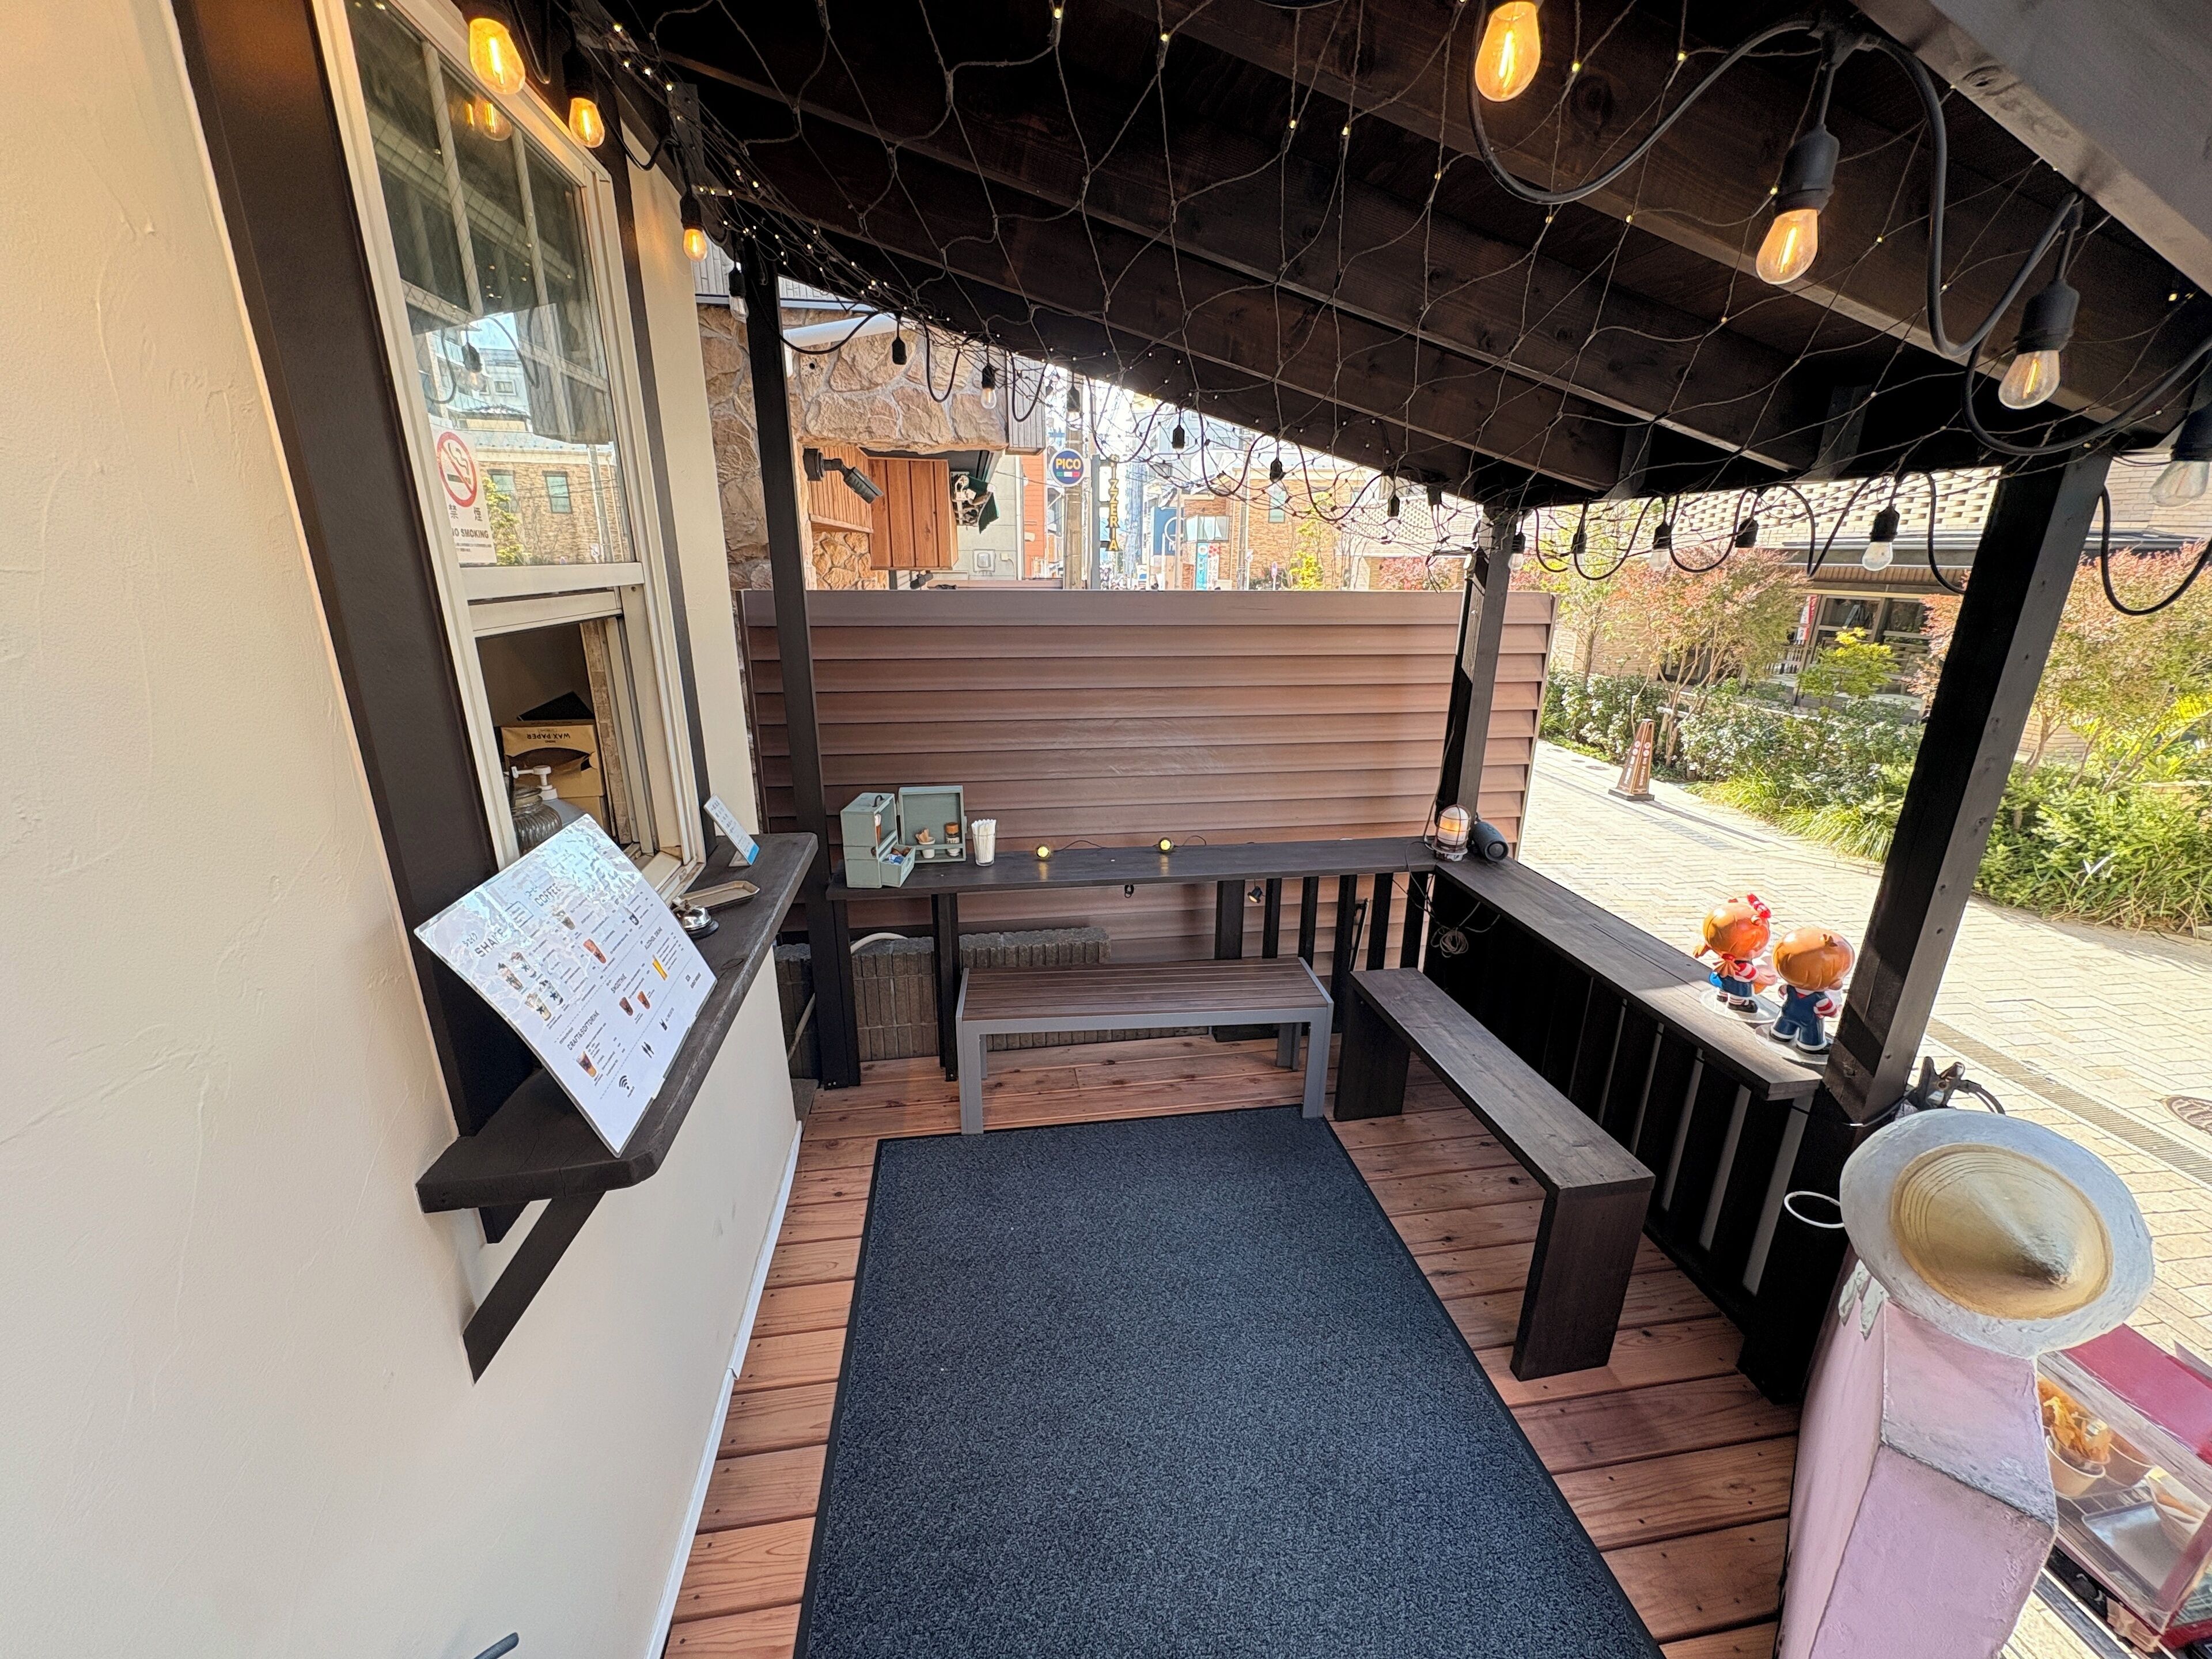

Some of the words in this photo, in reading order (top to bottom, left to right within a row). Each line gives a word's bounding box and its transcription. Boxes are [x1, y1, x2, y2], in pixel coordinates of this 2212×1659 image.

[1055, 458, 1081, 470] PICO
[1108, 454, 1119, 551] PIZZERIA
[460, 528, 489, 539] SMOKING
[534, 882, 562, 907] COFFEE
[475, 928, 507, 958] SHAKE
[611, 973, 628, 994] SMOOTHIE
